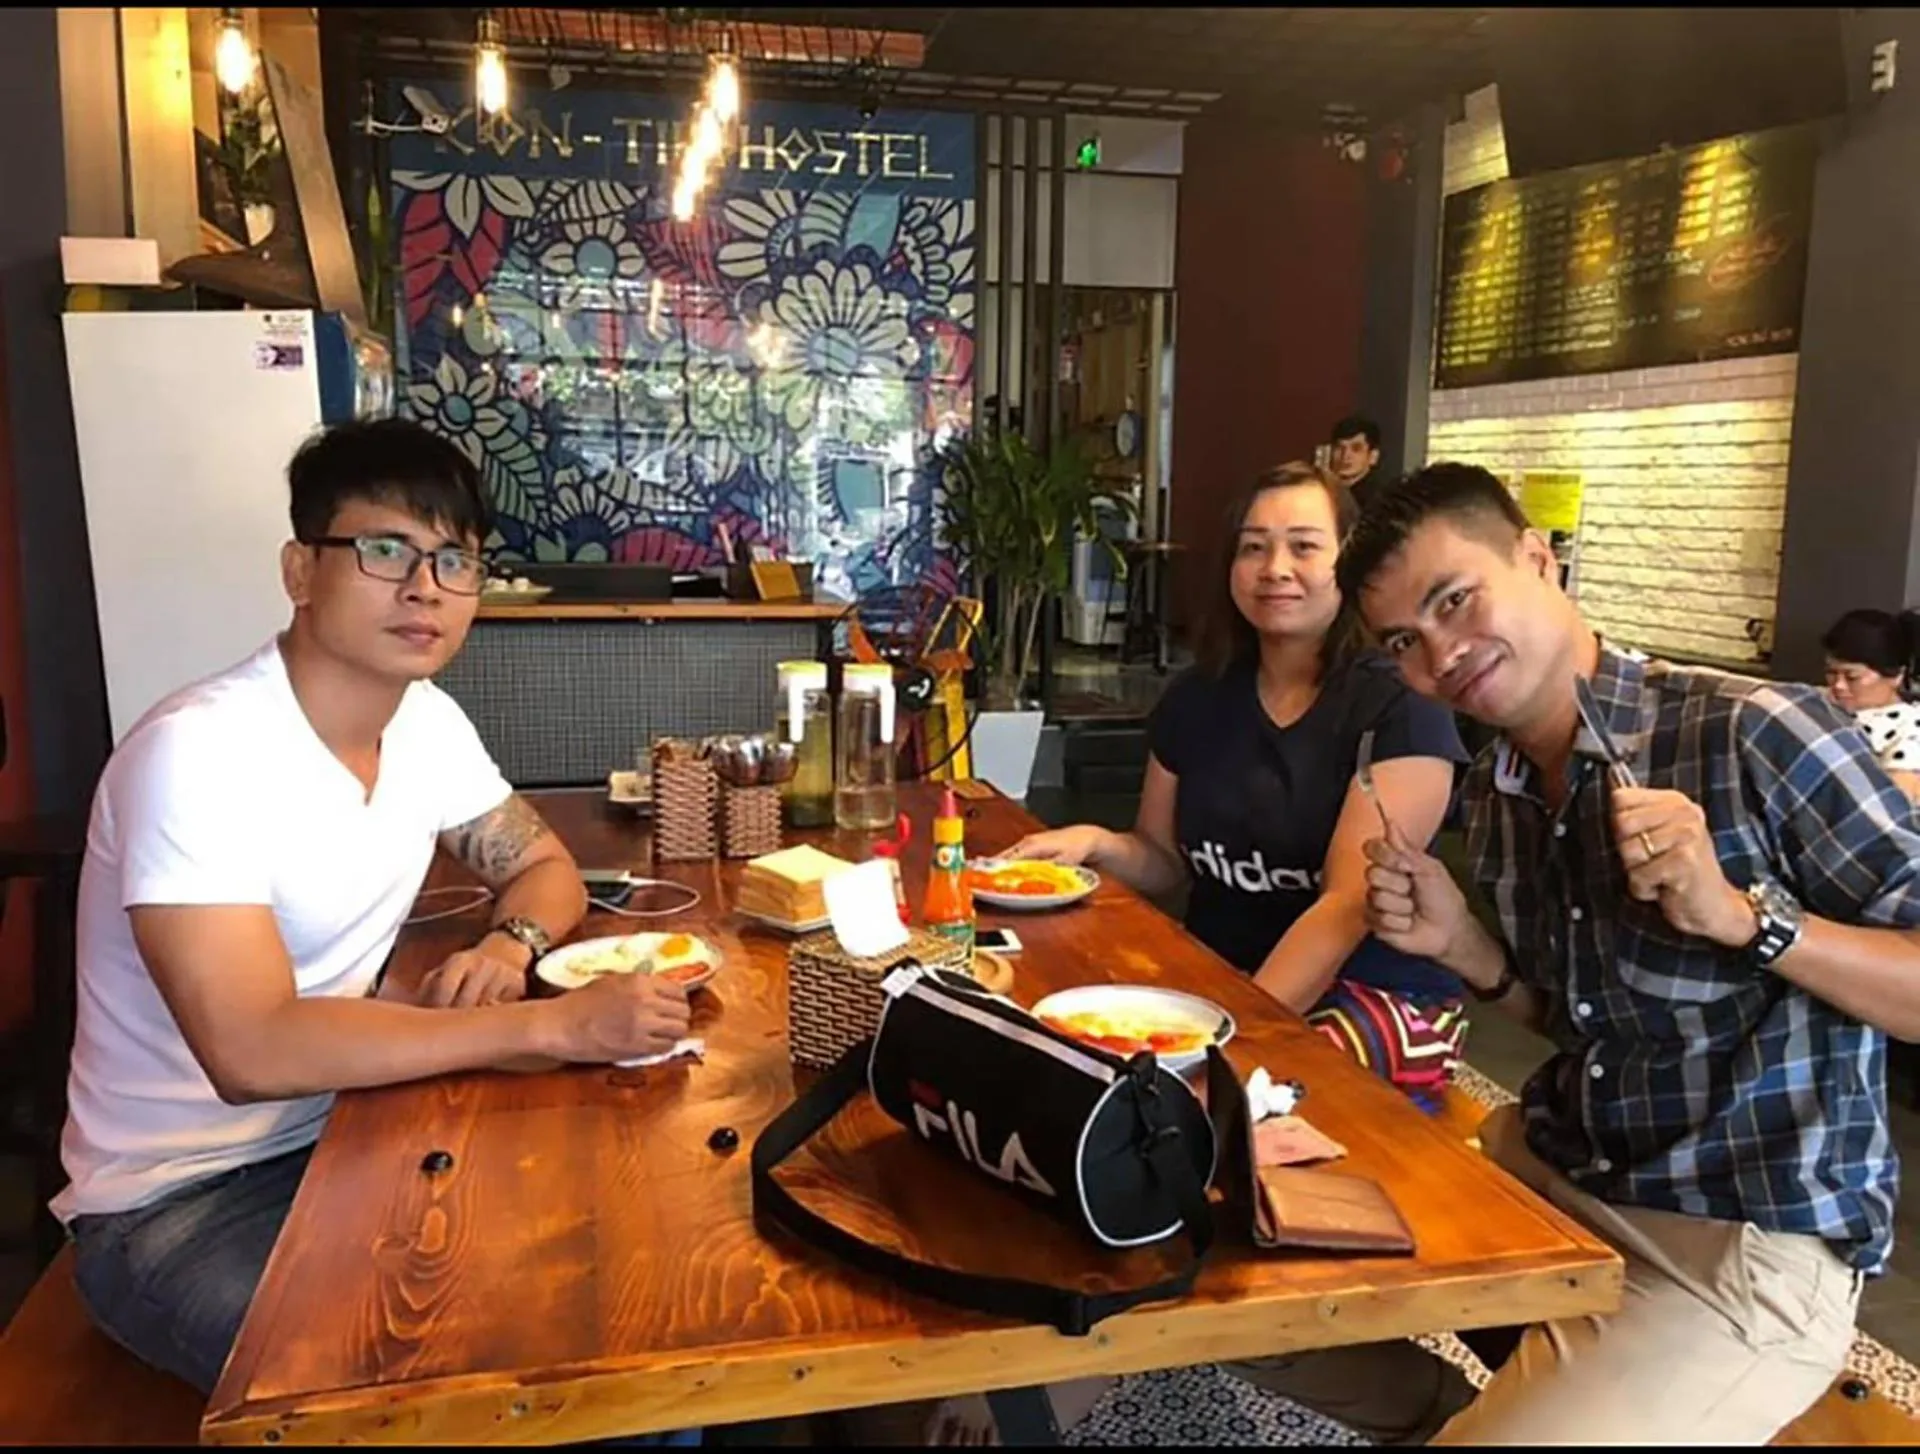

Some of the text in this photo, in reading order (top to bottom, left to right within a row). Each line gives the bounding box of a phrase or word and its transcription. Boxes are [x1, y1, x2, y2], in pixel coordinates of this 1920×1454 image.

[739, 124, 953, 179] HOSTEL
[1181, 840, 1323, 893] dida
[908, 1076, 1056, 1197] FILA
